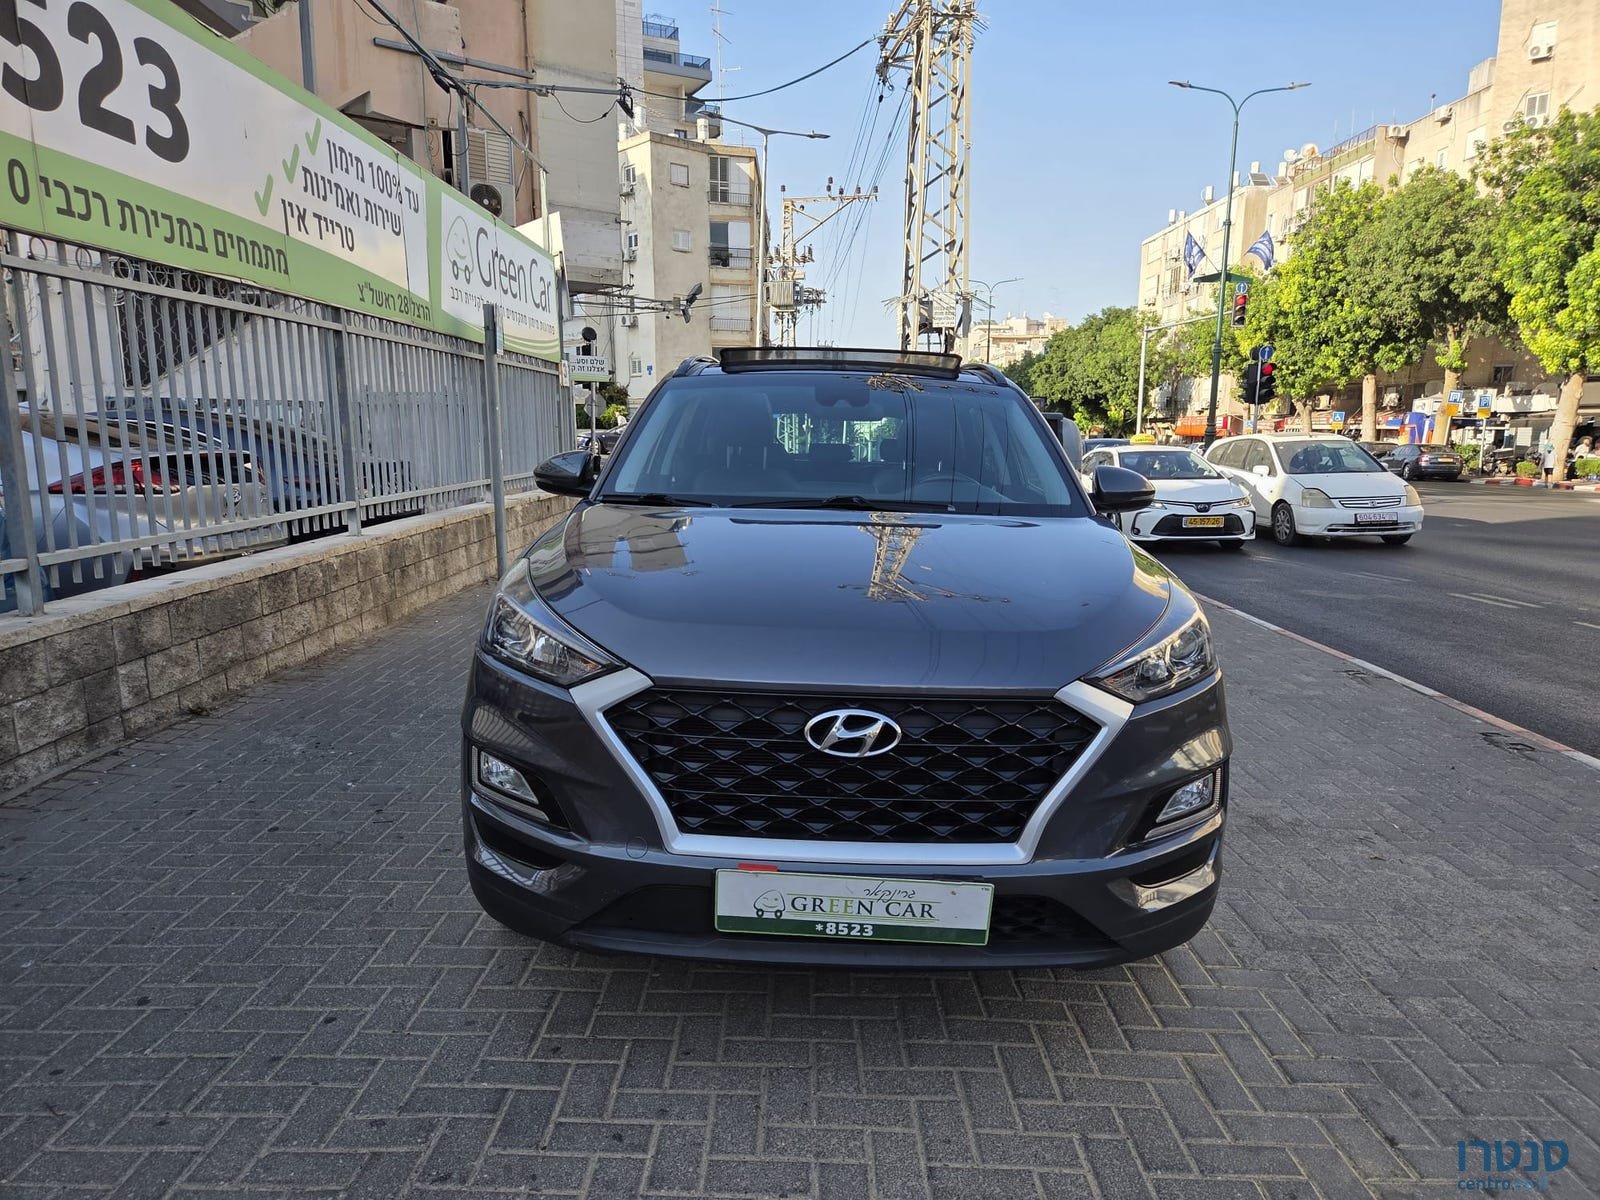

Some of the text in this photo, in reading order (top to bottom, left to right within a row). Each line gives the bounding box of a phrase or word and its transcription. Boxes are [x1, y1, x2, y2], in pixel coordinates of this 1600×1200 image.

[0, 0, 190, 163] 523
[39, 175, 110, 227] רכבי
[301, 165, 401, 236] שירות ואמינות
[326, 138, 419, 213] עד 100% מימון
[117, 198, 209, 254] במכירת
[213, 228, 289, 275] מתמחים
[281, 198, 355, 252] טרייד אין
[450, 286, 463, 302] רכב
[476, 226, 551, 313] Green Car
[397, 293, 410, 315] 28
[410, 297, 431, 321] הרצל
[790, 896, 935, 919] GREEN CAR
